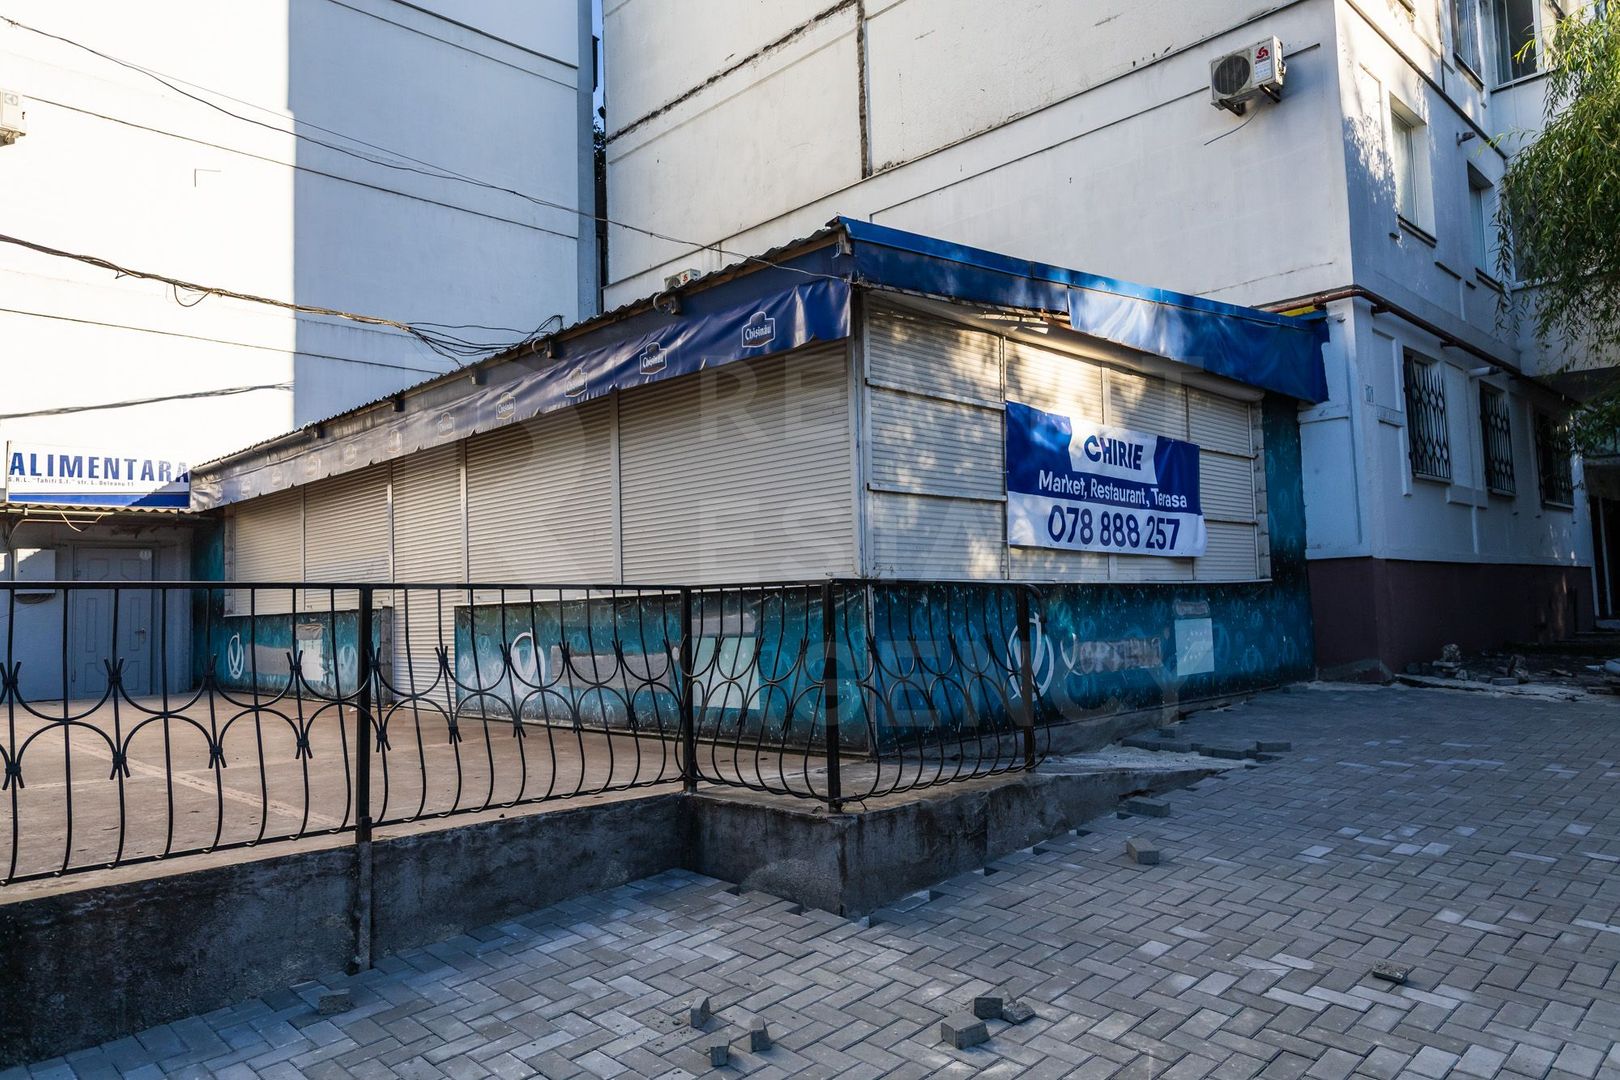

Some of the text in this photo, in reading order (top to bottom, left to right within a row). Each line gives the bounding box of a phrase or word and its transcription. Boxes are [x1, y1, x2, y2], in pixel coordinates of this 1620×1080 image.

[8, 452, 189, 483] ALIMENTARA
[1084, 435, 1144, 470] CHIRIE
[1039, 469, 1188, 508] Market, Restaurant, Terasa
[1048, 505, 1180, 550] 078 888 257
